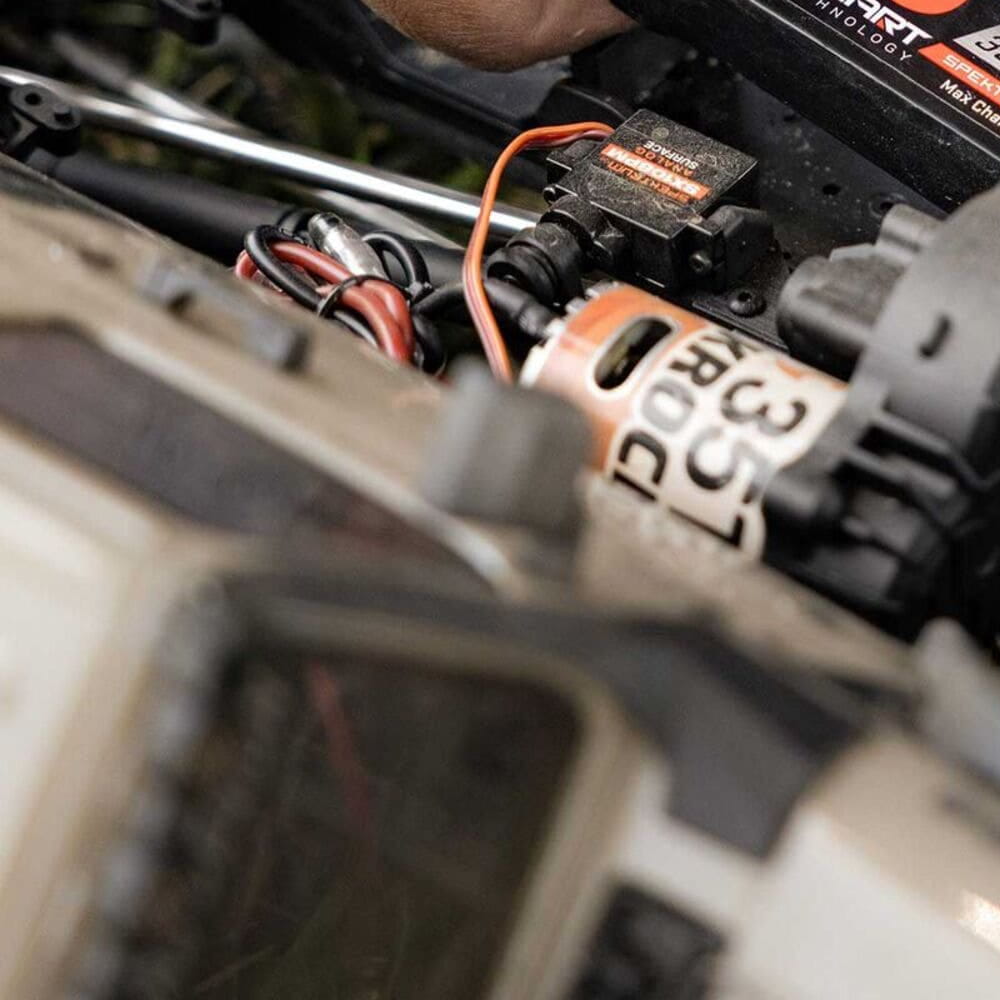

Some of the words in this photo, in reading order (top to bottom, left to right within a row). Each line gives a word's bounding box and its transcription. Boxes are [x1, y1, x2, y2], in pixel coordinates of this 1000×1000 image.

[939, 79, 973, 105] Max
[635, 146, 695, 177] ANALOG
[643, 140, 699, 170] SURFACE
